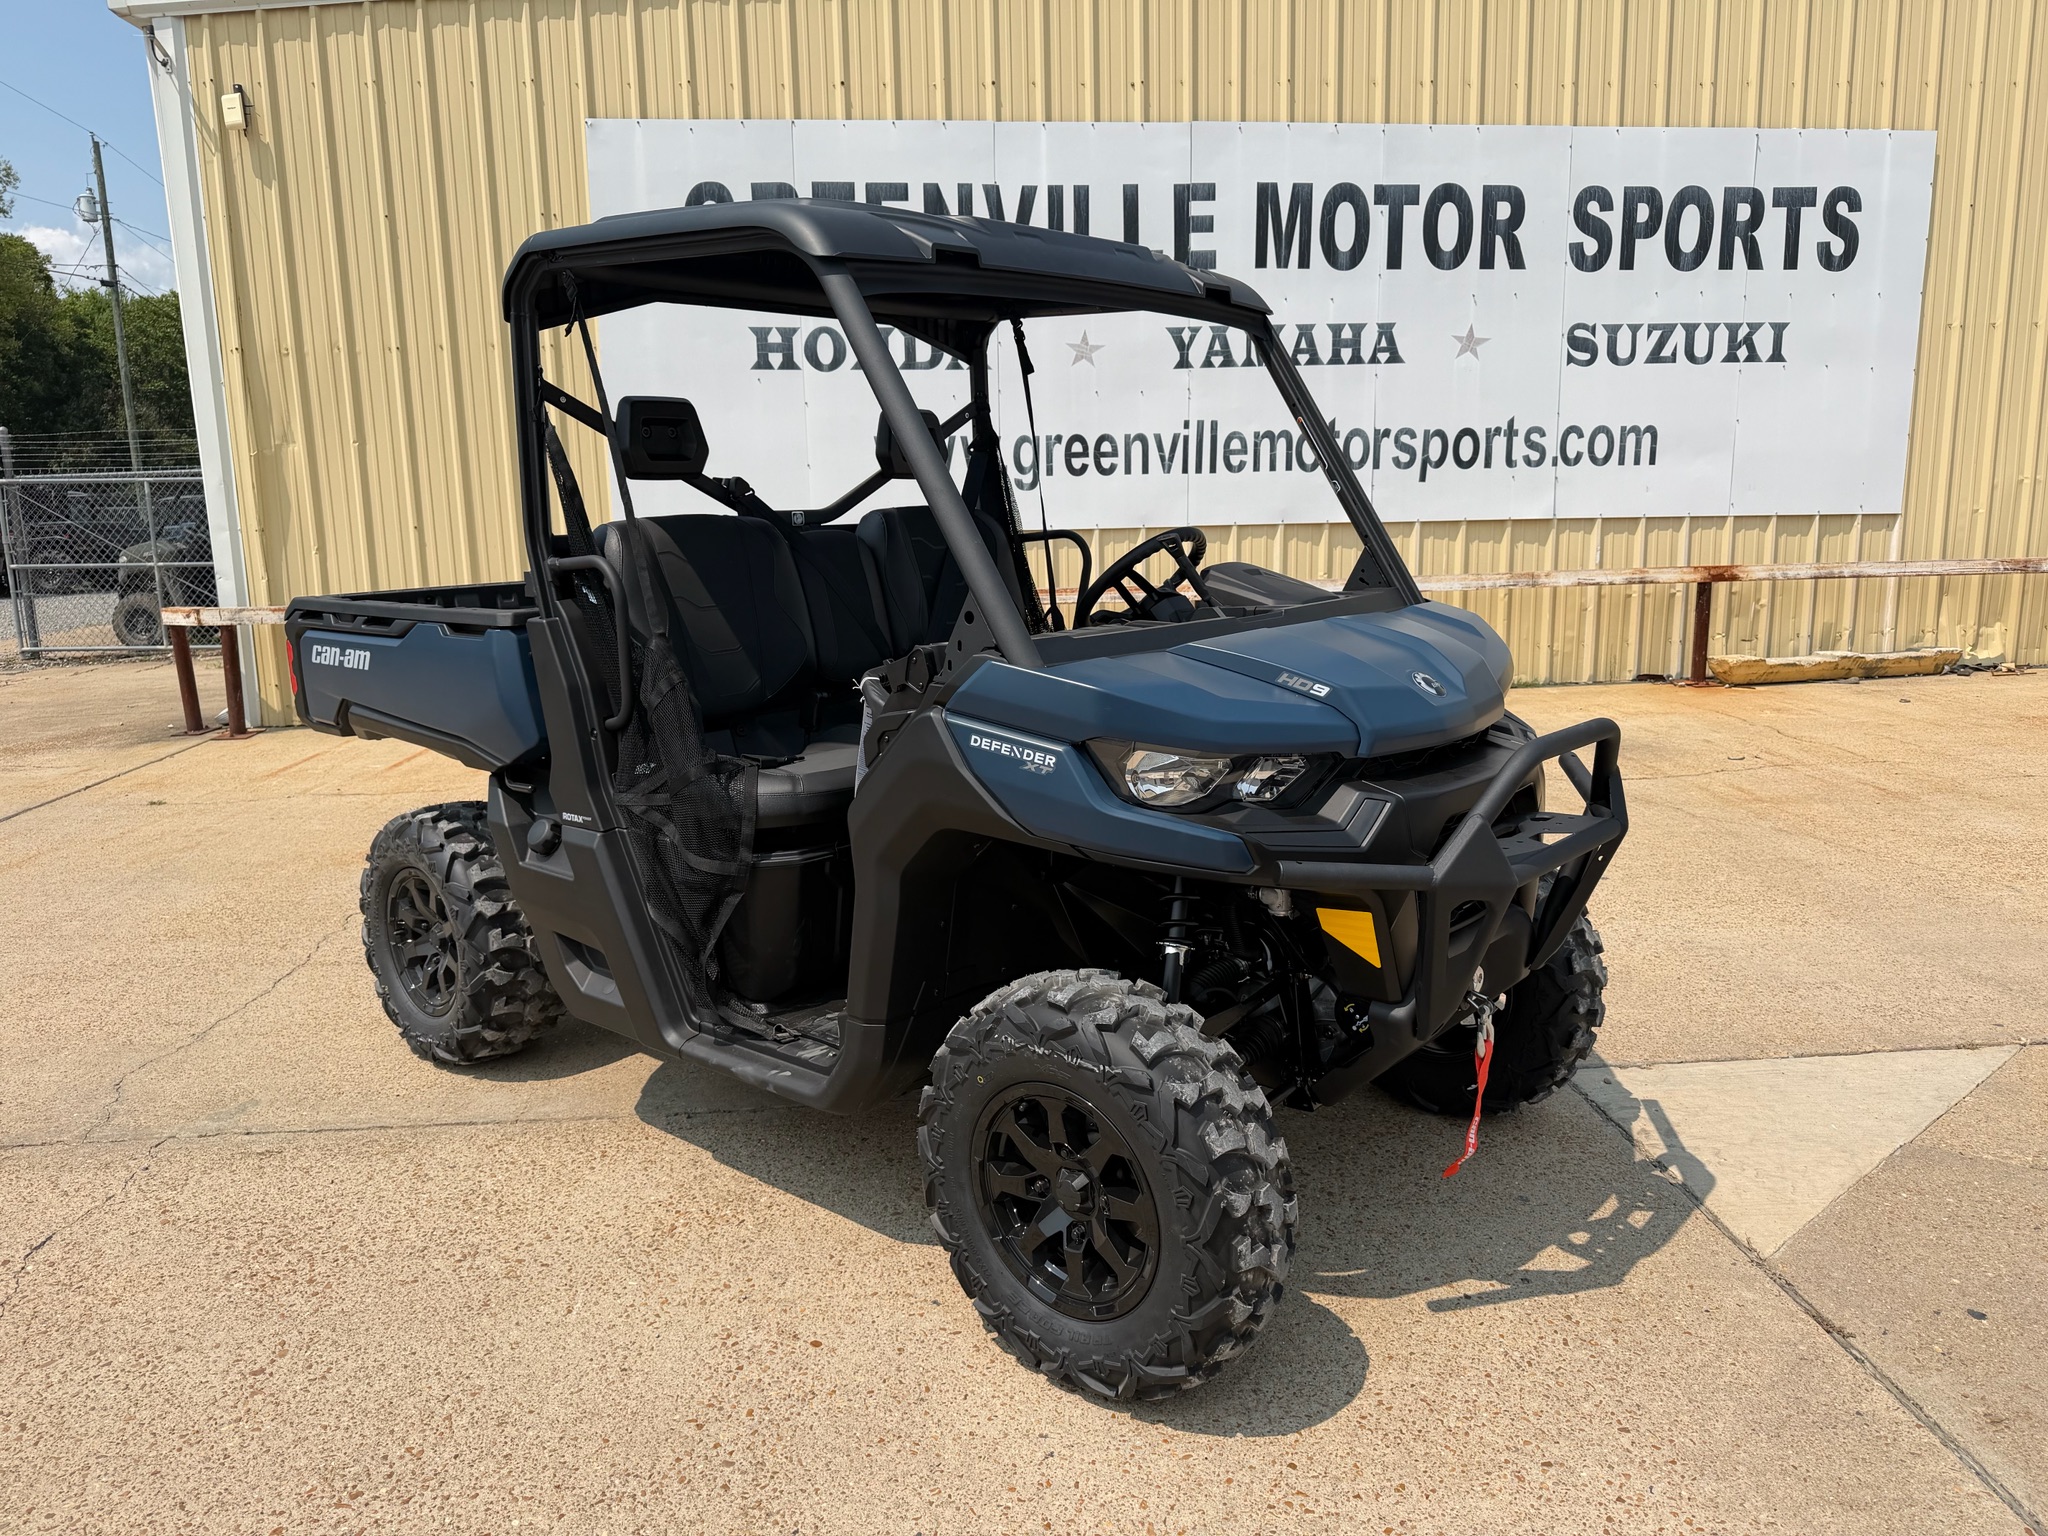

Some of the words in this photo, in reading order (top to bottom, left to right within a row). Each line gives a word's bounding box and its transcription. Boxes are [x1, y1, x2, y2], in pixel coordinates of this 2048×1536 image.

[1255, 181, 1526, 271] MOTOR
[1568, 184, 1863, 272] SPORTS
[748, 325, 992, 373] HOD
[1566, 322, 1790, 367] SUZUKI
[311, 644, 371, 671] can-am
[1277, 672, 1330, 697] HD9
[970, 734, 1056, 768] DEFENDER
[1023, 761, 1053, 774] XT
[562, 812, 583, 823] ROTAX
